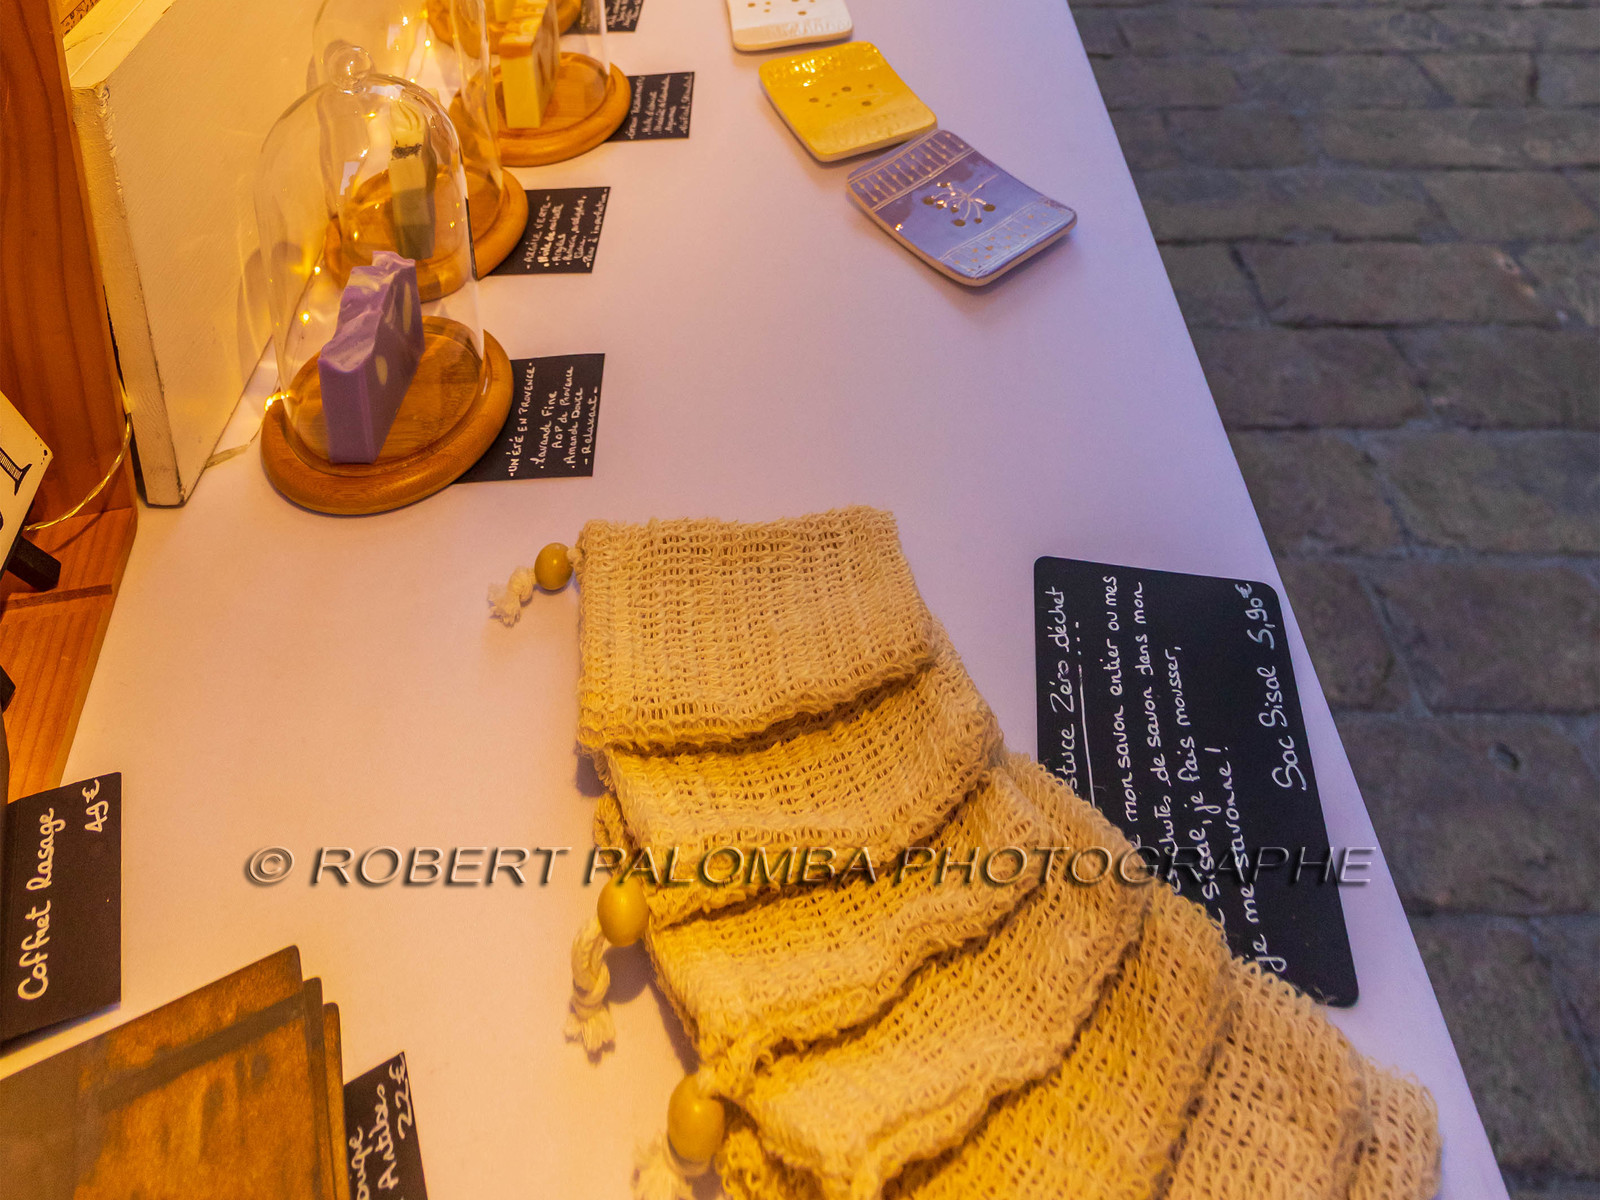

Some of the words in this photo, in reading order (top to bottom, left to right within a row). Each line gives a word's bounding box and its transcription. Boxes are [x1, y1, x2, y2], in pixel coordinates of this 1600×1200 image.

[518, 366, 536, 415] PROVENCE
[517, 417, 529, 432] EN
[552, 425, 564, 449] AOP
[557, 411, 568, 424] de
[508, 457, 520, 472] UN
[563, 421, 579, 464] Amande
[1103, 574, 1118, 607] mes
[1134, 581, 1148, 625] mon
[1045, 585, 1070, 653] déchet
[1107, 611, 1121, 632] ou
[1099, 638, 1124, 697] entier
[1135, 633, 1155, 676] dans
[1049, 659, 1075, 714] Zéro
[1164, 645, 1192, 726] mousser,
[1256, 665, 1289, 729] Sisal
[1112, 704, 1131, 769] savon
[1144, 686, 1163, 749] savon
[1056, 723, 1079, 796] stuce
[1150, 752, 1172, 788] de
[1176, 735, 1202, 783] fais
[1272, 735, 1308, 792] Sac
[1120, 771, 1138, 822] mon
[1184, 790, 1222, 814] je
[25, 807, 67, 891] Rasage
[1239, 880, 1261, 924] me
[17, 899, 52, 1001] Coffret
[1244, 933, 1288, 973] je
[388, 1052, 413, 1140] 22€
